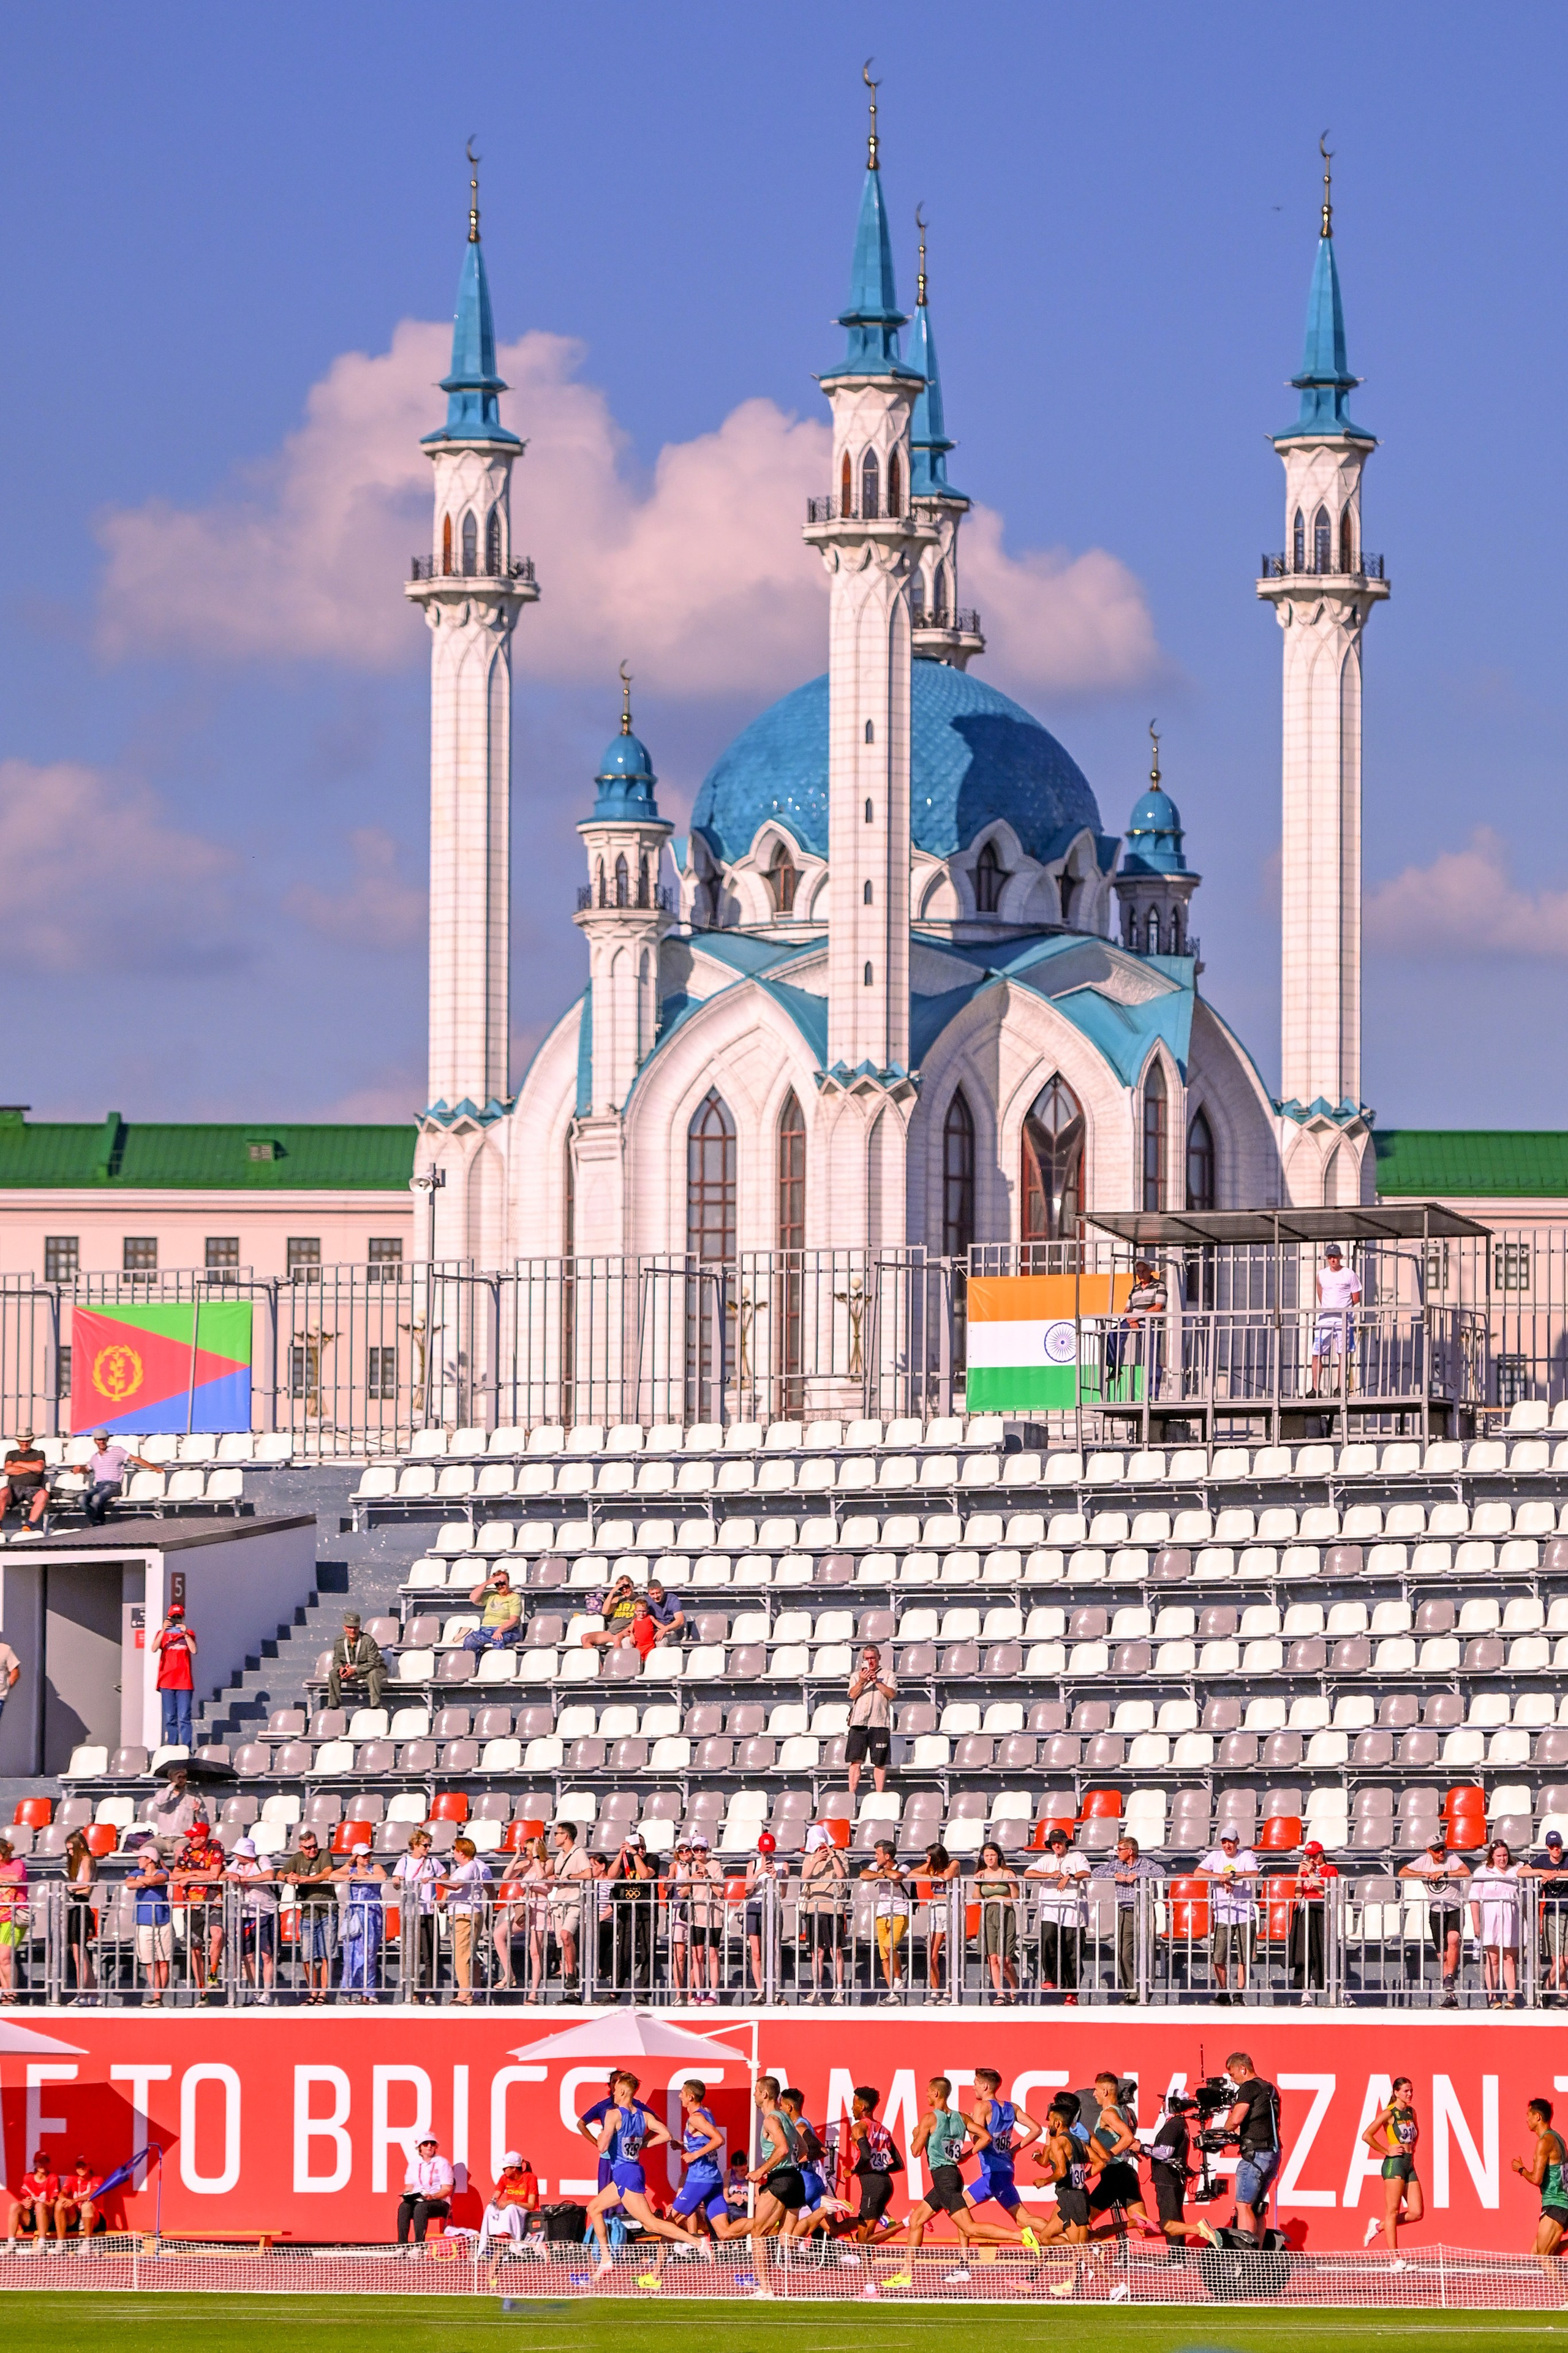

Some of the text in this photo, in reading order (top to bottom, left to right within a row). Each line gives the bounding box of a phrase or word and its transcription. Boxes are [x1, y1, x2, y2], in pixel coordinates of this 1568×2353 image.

[175, 1577, 183, 1597] 5
[0, 2063, 79, 2191] E
[110, 2063, 242, 2194] TO
[293, 2065, 617, 2196] BRICS
